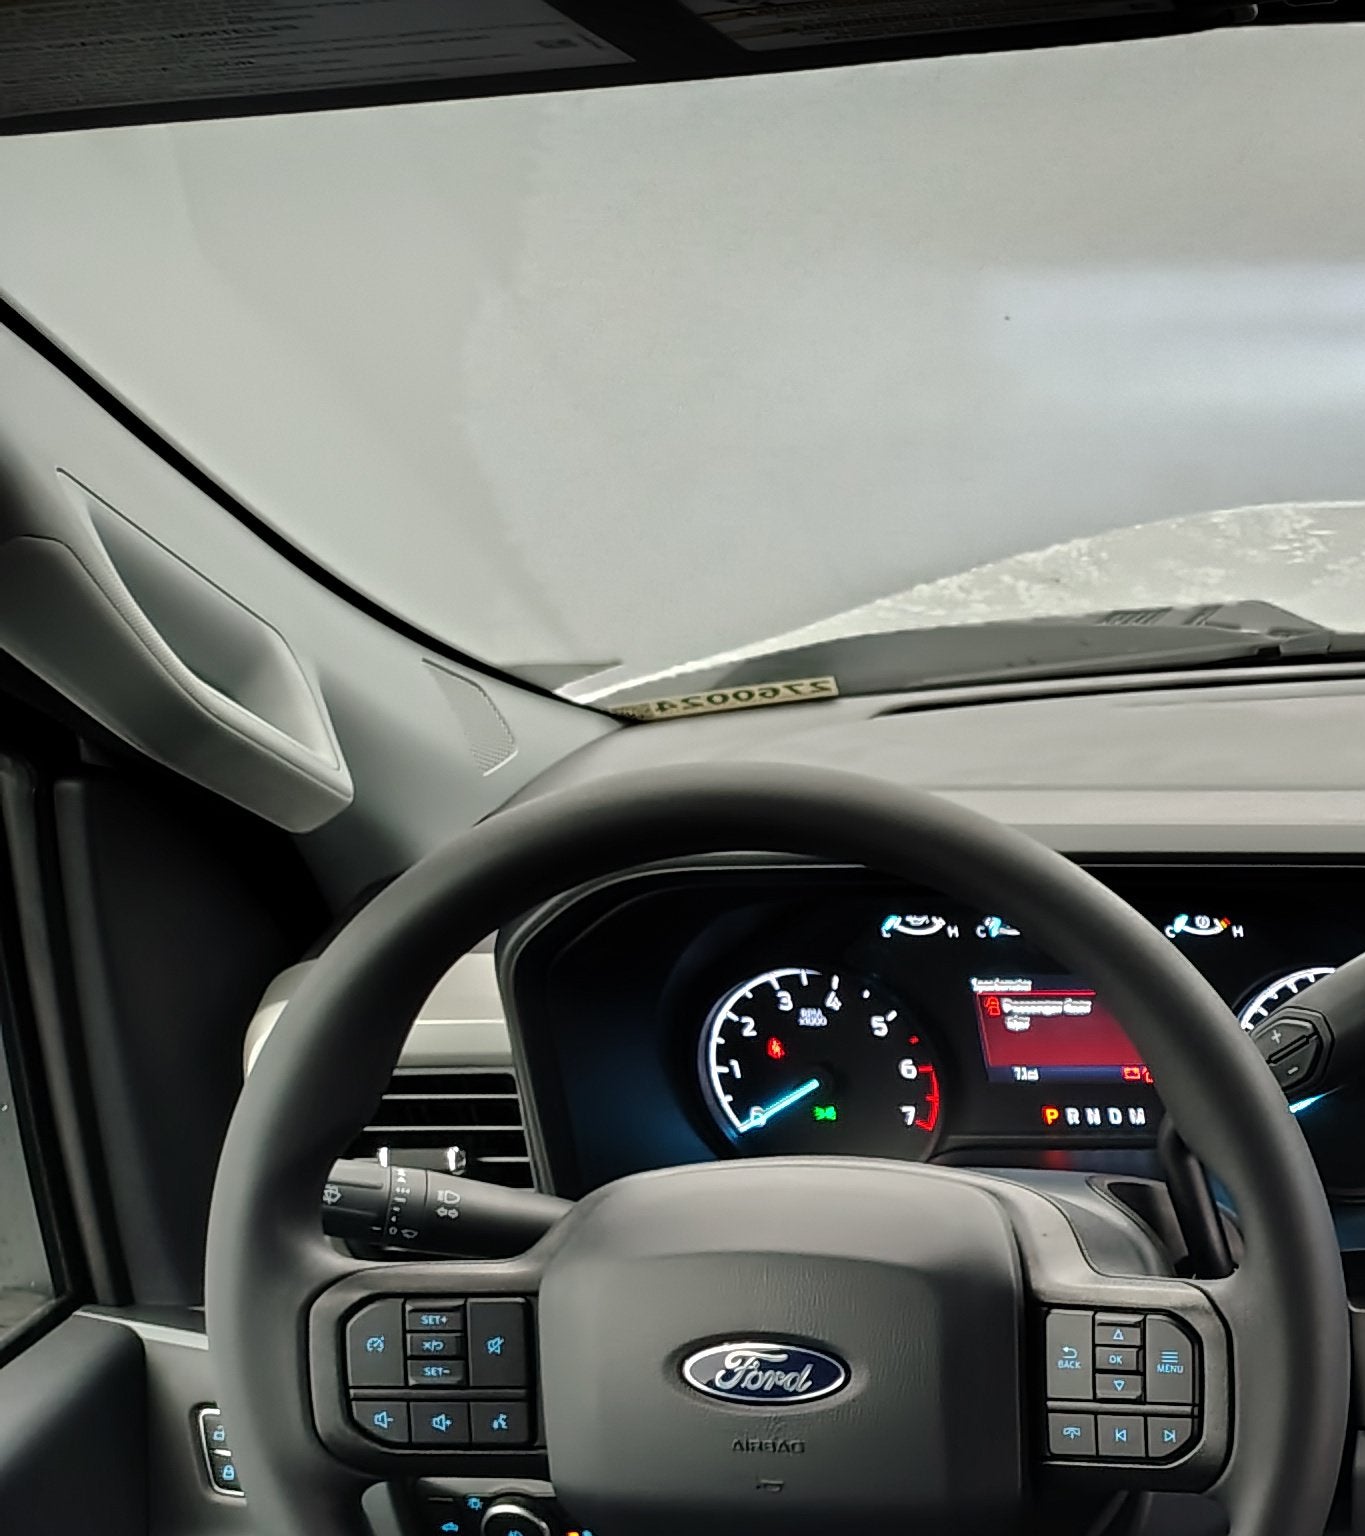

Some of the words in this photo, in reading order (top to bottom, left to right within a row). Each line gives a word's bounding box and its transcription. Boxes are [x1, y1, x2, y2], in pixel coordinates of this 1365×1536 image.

[947, 925, 960, 938] H
[1232, 925, 1244, 938] H
[776, 991, 793, 1011] 3
[825, 991, 842, 1011] 4
[739, 1016, 757, 1037] 2
[870, 1016, 888, 1037] 5
[729, 1059, 741, 1078] 1
[899, 1059, 917, 1079] 6
[900, 1106, 916, 1126] 7
[1044, 1106, 1060, 1124] P
[1065, 1107, 1080, 1125] R
[1085, 1107, 1101, 1125] N
[1106, 1107, 1123, 1125] D
[1057, 1359, 1081, 1370] BACK
[1109, 1354, 1123, 1364] OK
[1157, 1363, 1184, 1374] MENU
[714, 1348, 813, 1394] Ford
